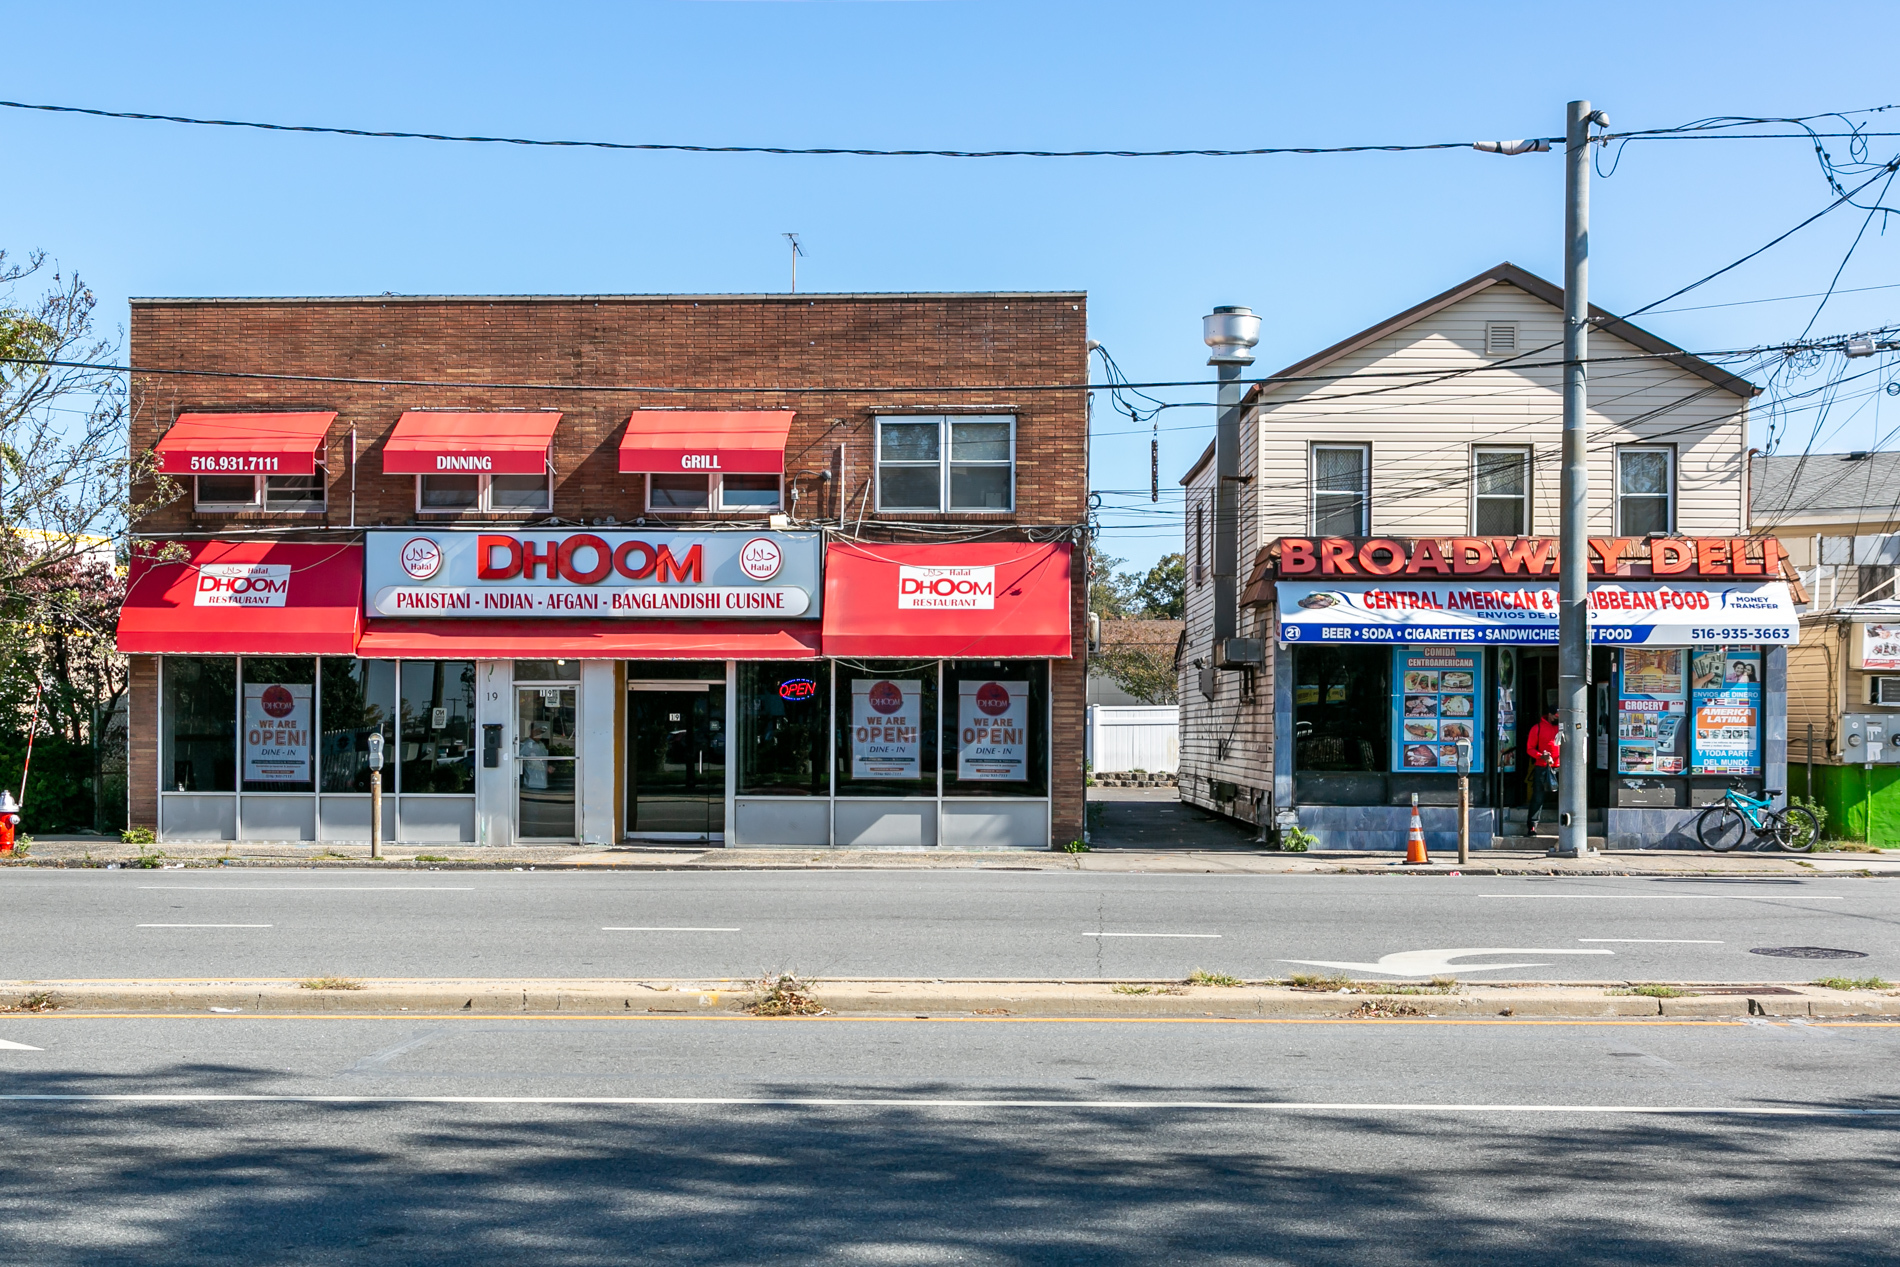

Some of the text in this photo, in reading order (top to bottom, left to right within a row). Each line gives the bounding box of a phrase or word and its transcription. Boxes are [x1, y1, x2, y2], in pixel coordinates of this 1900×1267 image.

[190, 456, 279, 471] 516.931.7111
[436, 455, 492, 470] DINNING
[681, 454, 722, 469] GRILL
[406, 547, 436, 561] حلال
[477, 533, 703, 584] DHOOM
[746, 547, 777, 561] حلال
[1650, 538, 1779, 575] DELI
[410, 563, 432, 571] Halal
[750, 563, 772, 572] Halal
[199, 576, 287, 594] DHOOM
[901, 578, 992, 597] DHOOM
[209, 596, 271, 604] RESTAURANT
[397, 592, 470, 609] PAKISTANI
[484, 593, 533, 609] INDIAN
[546, 593, 598, 609] AFGANI
[612, 592, 720, 609] BANGLANDISHI
[726, 592, 785, 609] CUISINE
[913, 599, 977, 607] RESTAURANT
[1363, 590, 1710, 610] CENTRAL AMERICAN & IBBEAN FOOD
[1477, 611, 1525, 619] ENVIOS
[1287, 628, 1299, 637] 21
[1322, 627, 1352, 639] BEER
[1361, 627, 1394, 640] SODA
[1404, 627, 1475, 640] CIGARETTES
[1599, 628, 1632, 640] FOOD
[1691, 628, 1790, 639] 516-935-3663
[1424, 647, 1457, 657] COMIDA
[1407, 658, 1474, 668] CENTROAMERICANA
[779, 682, 816, 697] OPEN
[487, 692, 498, 701] 19
[1625, 701, 1664, 711] GROCERY
[1702, 708, 1752, 716] AMERICA
[258, 719, 297, 729] WE ARE
[867, 716, 906, 725] WE ARE
[973, 718, 1013, 727] WE ARE
[249, 729, 308, 747] OPEN!
[856, 726, 917, 743] OPEN!
[962, 727, 1023, 745] OPEN!
[261, 748, 281, 756] DINE
